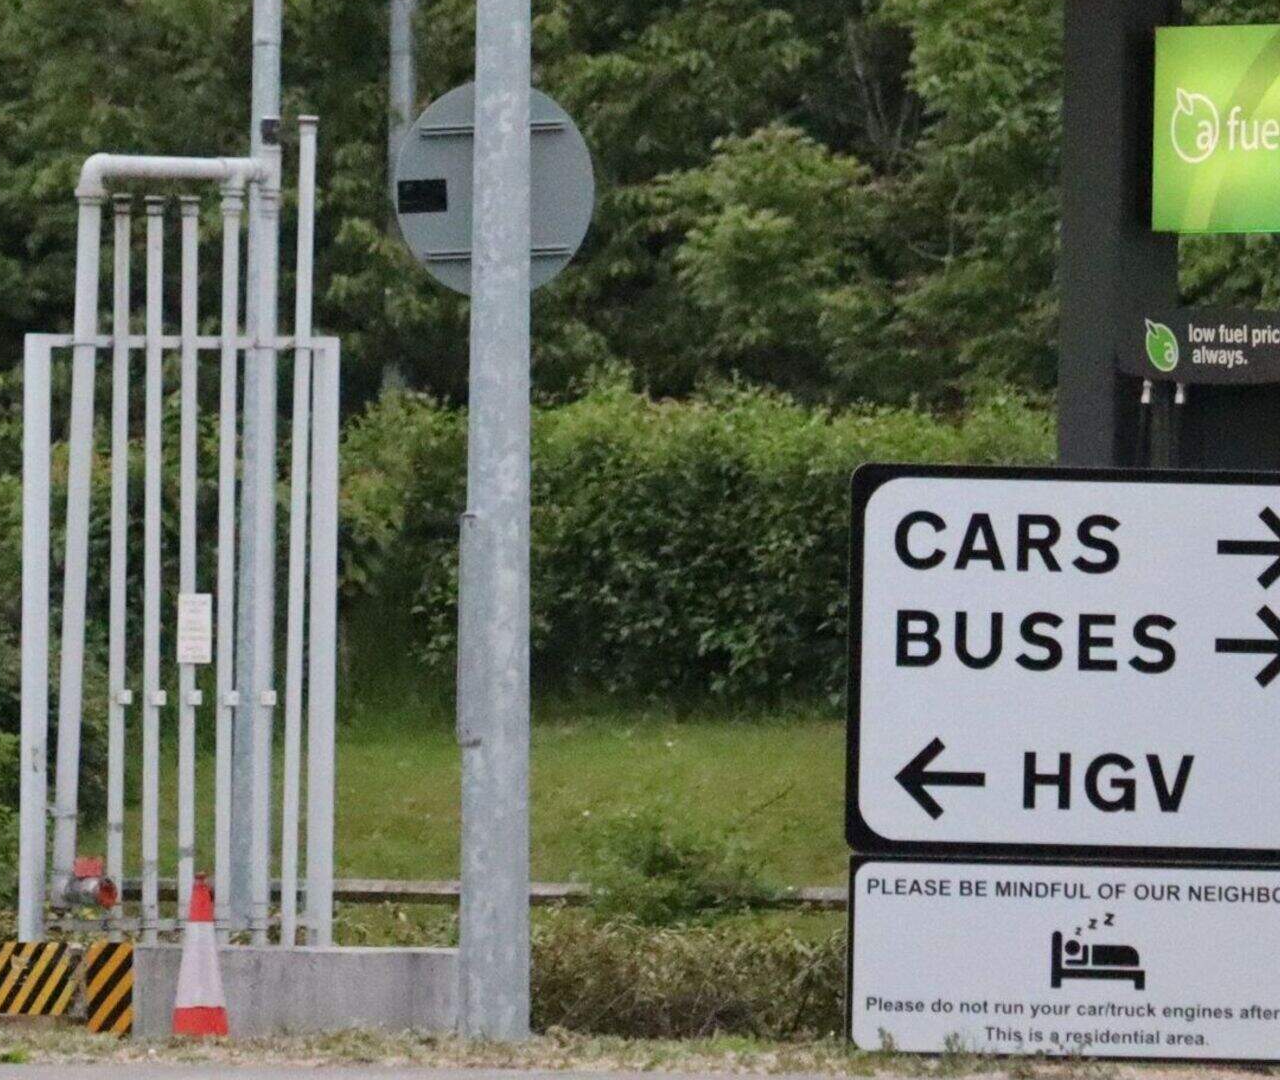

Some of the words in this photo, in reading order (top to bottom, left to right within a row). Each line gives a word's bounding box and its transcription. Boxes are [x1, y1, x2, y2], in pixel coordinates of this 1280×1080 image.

[1188, 323, 1215, 343] low
[1219, 323, 1248, 344] fuel
[1192, 346, 1248, 369] always.
[893, 509, 1122, 575] CARS
[894, 608, 1178, 675] BUSES
[1022, 750, 1195, 814] HGV
[866, 878, 952, 897] PLEASE
[959, 879, 988, 897] BE
[995, 880, 1092, 900] MINDFUL
[1098, 882, 1127, 900] OF
[1133, 884, 1181, 902] OUR
[865, 996, 925, 1013] Please
[931, 998, 953, 1013] do
[960, 999, 989, 1014] not
[995, 1001, 1025, 1015] run
[1031, 1003, 1071, 1019] your
[1076, 1001, 1157, 1018] car/truck
[1162, 1003, 1234, 1022] engines
[1239, 1004, 1280, 1020] after
[984, 1026, 1024, 1043] This
[1029, 1027, 1044, 1042] is
[1049, 1031, 1060, 1044] a
[1066, 1028, 1161, 1047] residential
[1165, 1031, 1210, 1047] area.
